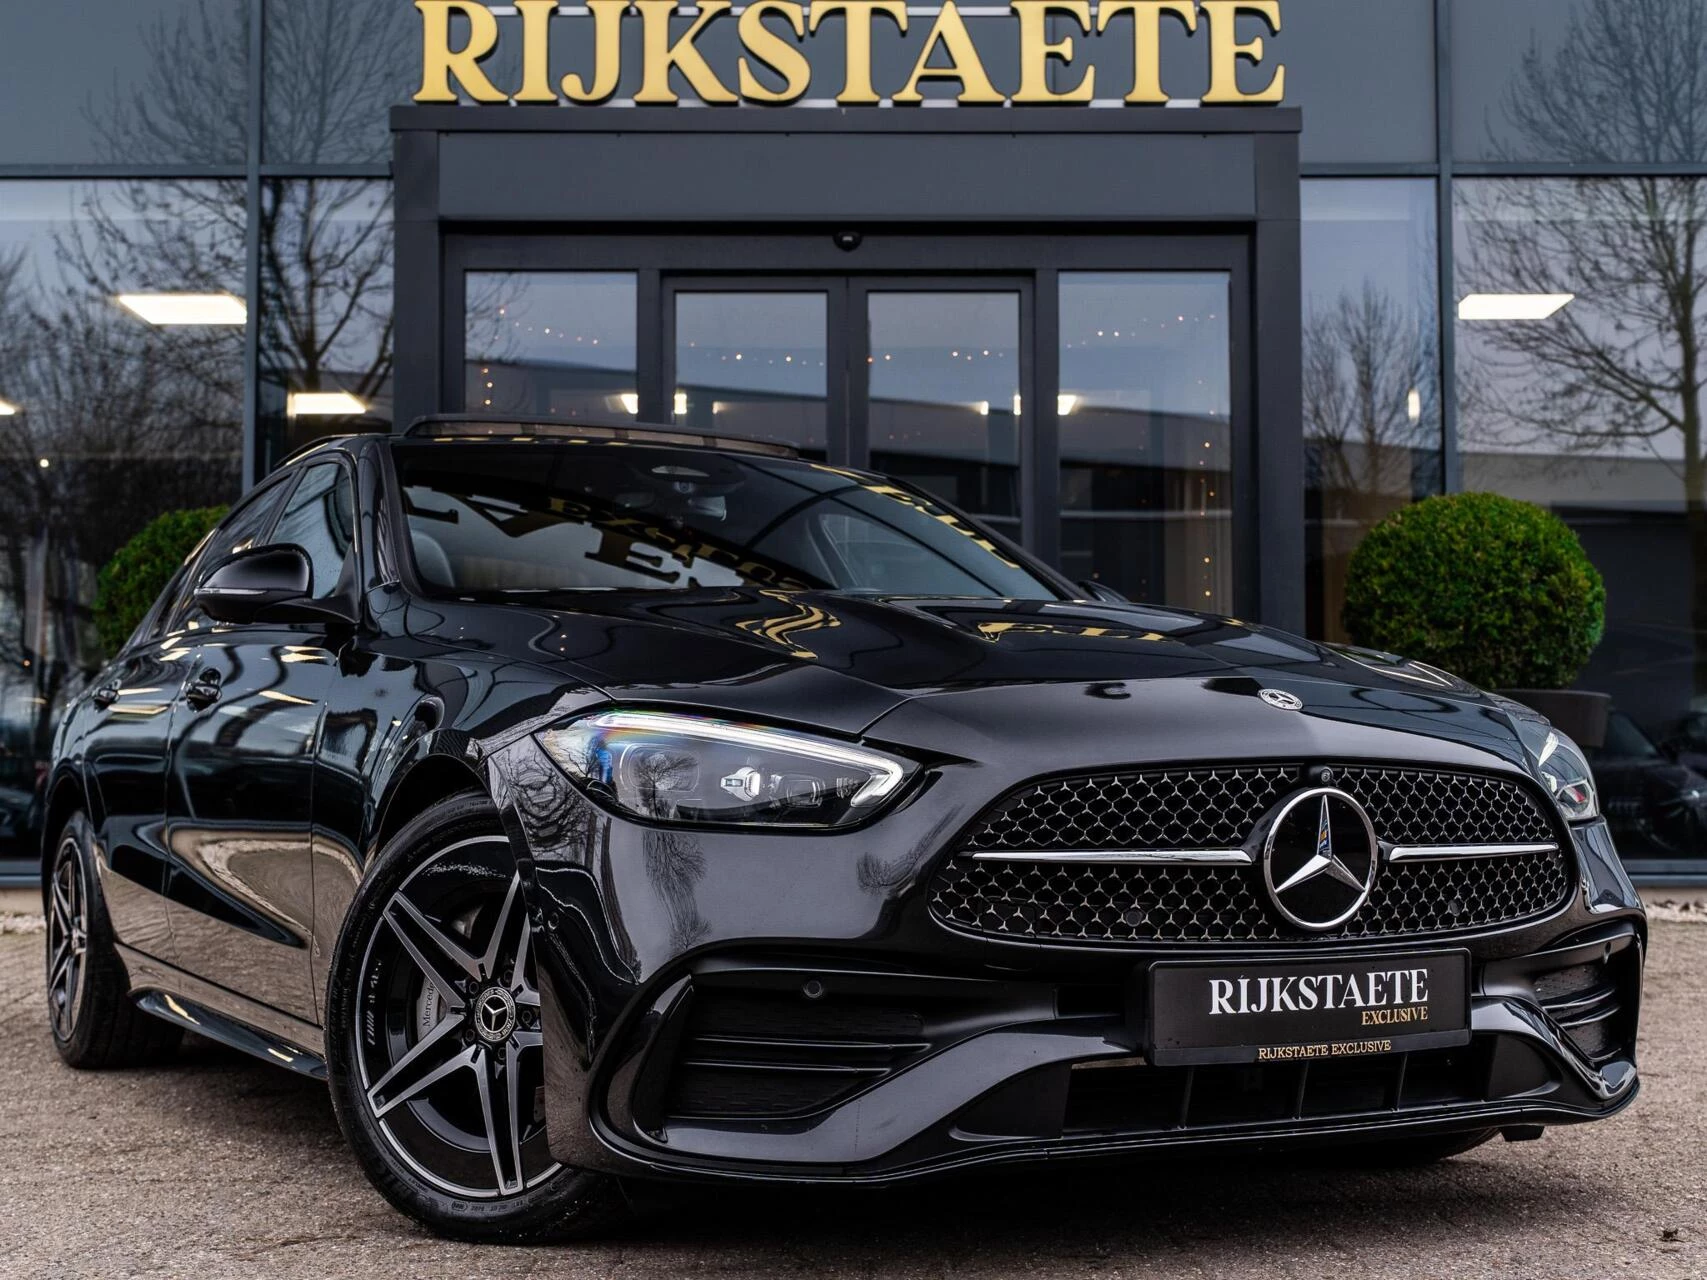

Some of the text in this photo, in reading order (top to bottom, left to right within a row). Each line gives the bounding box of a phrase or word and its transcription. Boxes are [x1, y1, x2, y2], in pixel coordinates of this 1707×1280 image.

[412, 0, 1285, 104] RIJKSTAETE
[1208, 968, 1429, 1015] RIJKSTAETE
[1361, 1006, 1428, 1026] EXCLUSIVE
[1258, 1039, 1392, 1060] RIJKSTAETE EXCLUSIVE
